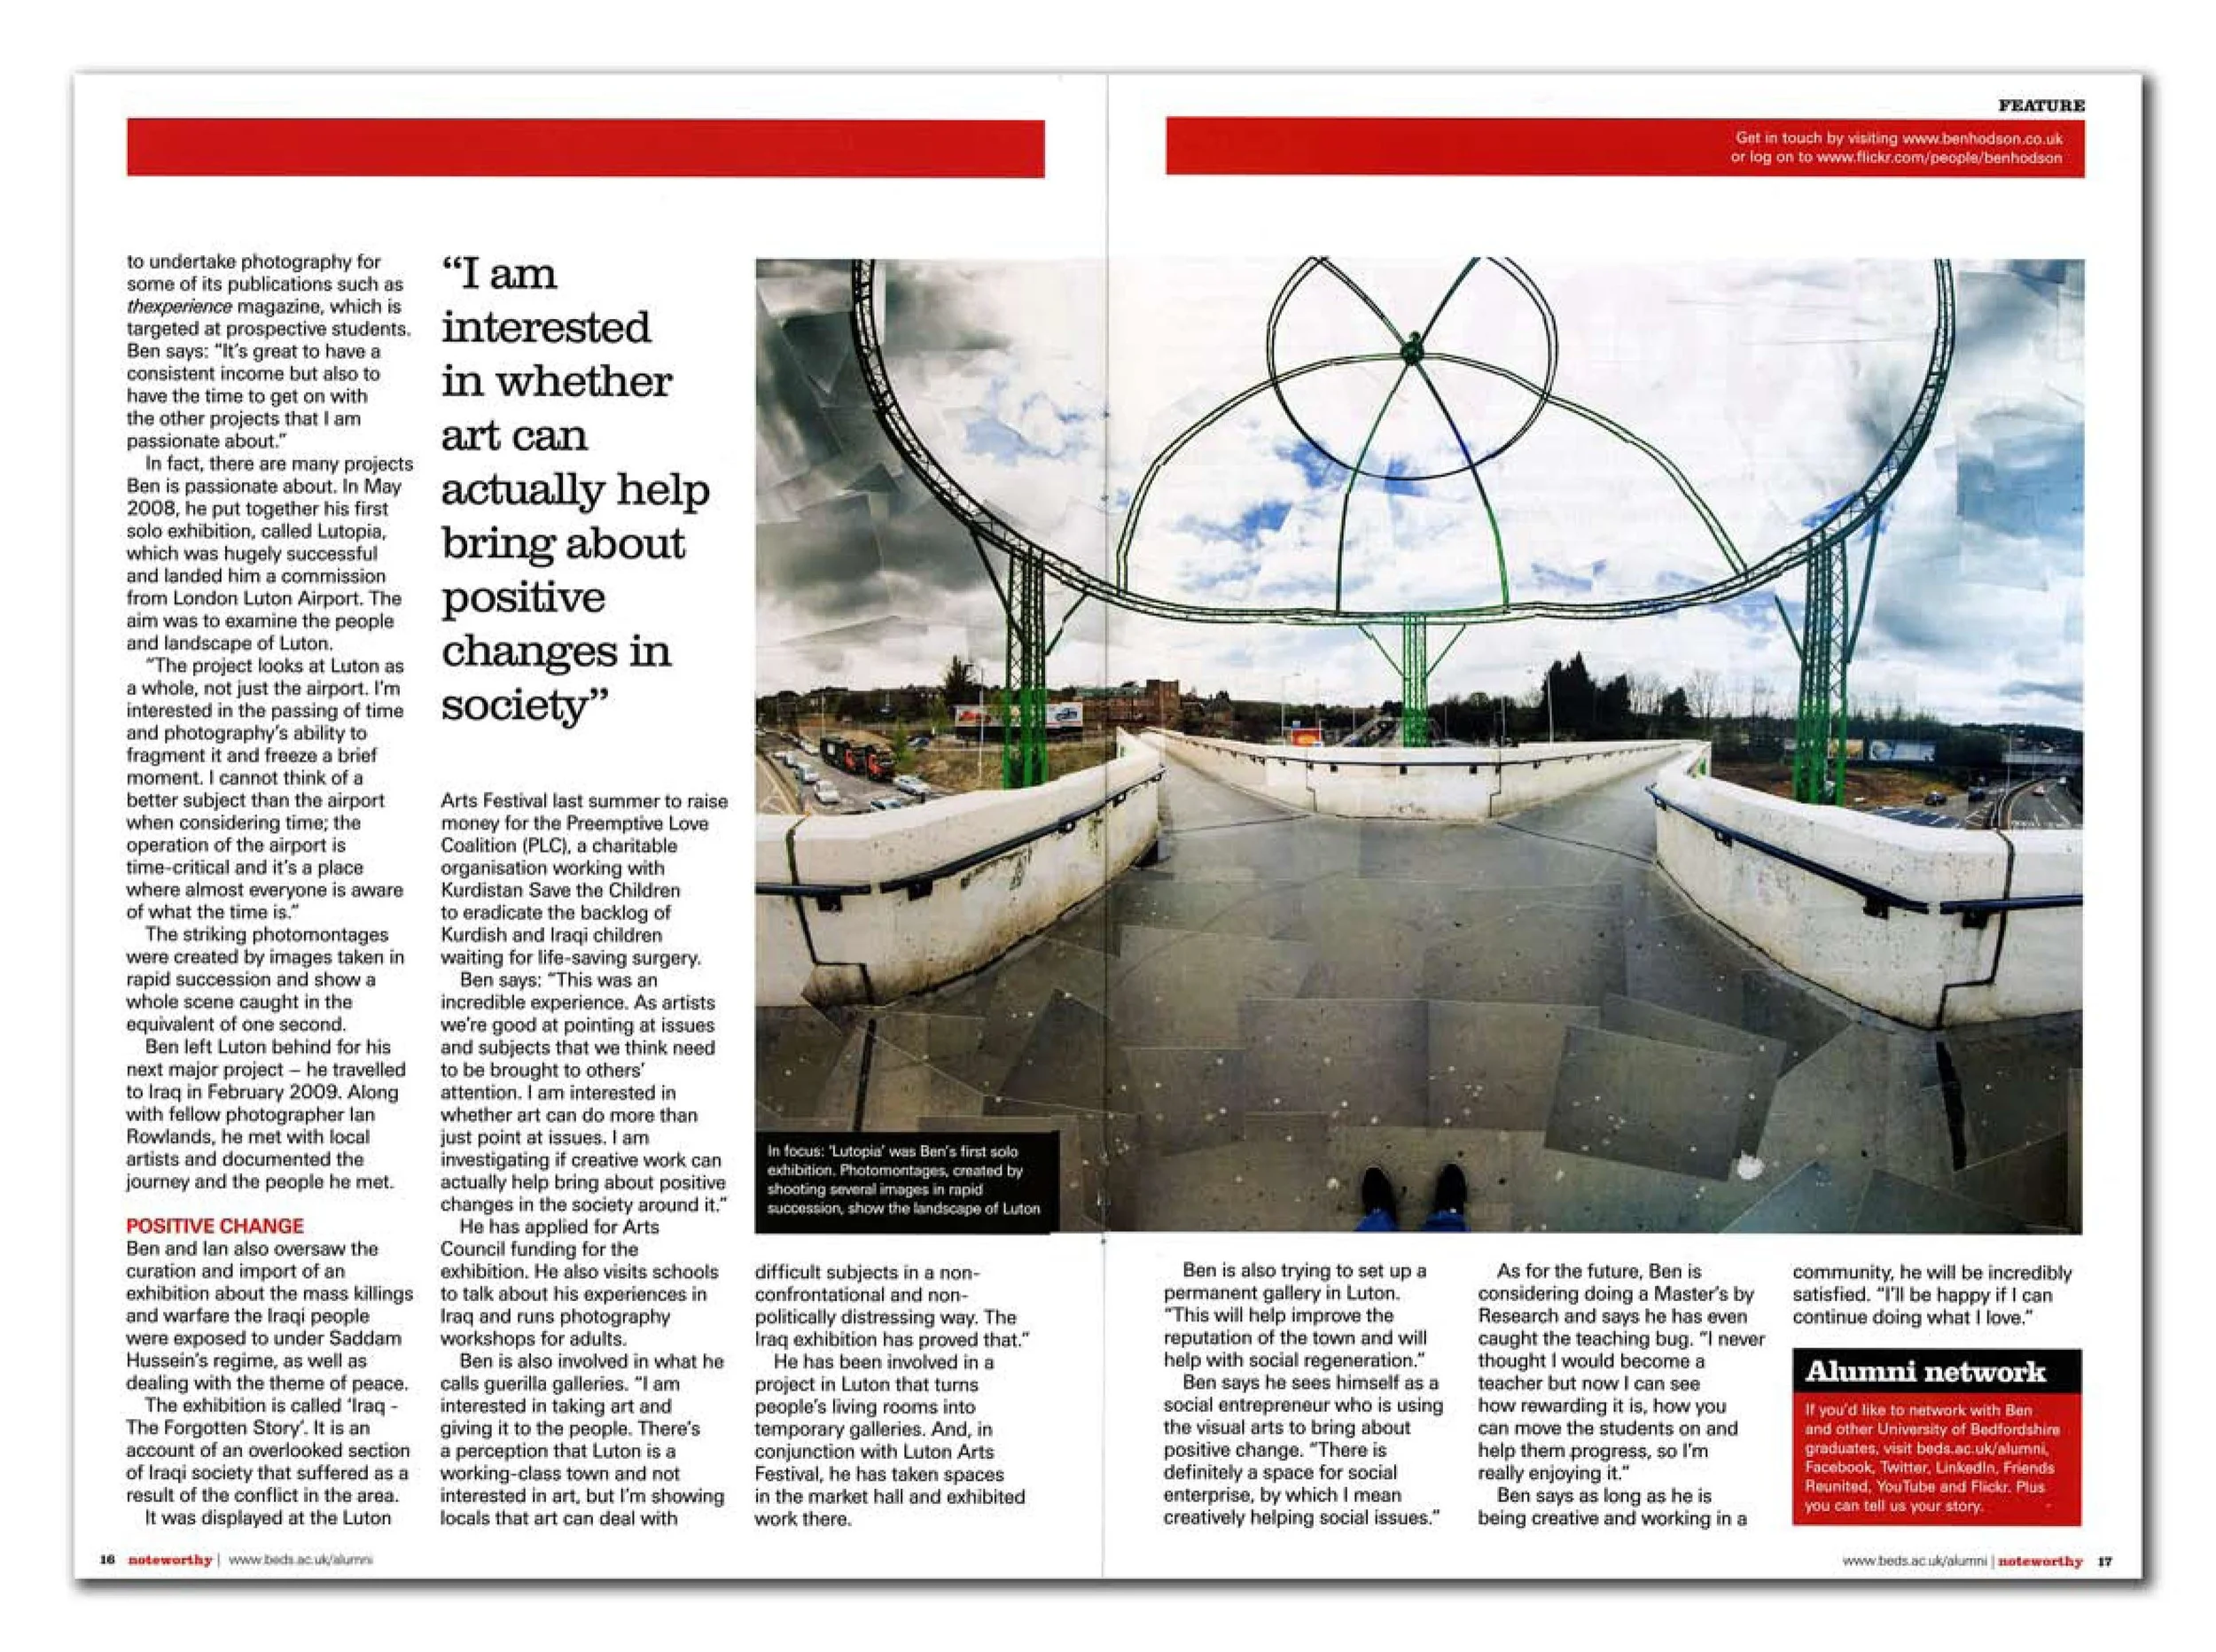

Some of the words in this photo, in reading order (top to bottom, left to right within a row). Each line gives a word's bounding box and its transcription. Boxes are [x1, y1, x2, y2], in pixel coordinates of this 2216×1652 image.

[1998, 98, 2086, 113] FEATURE
[1735, 130, 1761, 144] Get
[1765, 129, 1778, 144] in
[1782, 130, 1822, 145] touch
[1827, 130, 1845, 147] by
[1847, 129, 1899, 147] visiting
[1731, 152, 1746, 163] or
[1750, 150, 1772, 166] log
[1775, 152, 1795, 164] on
[1799, 151, 1814, 164] to
[127, 254, 145, 269] to
[149, 253, 238, 269] undertake
[241, 253, 352, 274] photography
[357, 253, 382, 269] for
[490, 264, 558, 290] am
[127, 297, 234, 318] thexperience
[238, 298, 325, 318] magazine,
[329, 298, 382, 315] which
[387, 298, 402, 315] is
[441, 308, 654, 345] interested
[441, 362, 486, 397] in
[495, 363, 675, 399] whether
[441, 419, 502, 452] art
[511, 425, 590, 452] can
[441, 471, 607, 515] actually
[616, 471, 711, 516] help
[127, 522, 164, 540] solo
[167, 522, 256, 541] exhibition,
[260, 522, 313, 540] called
[317, 522, 387, 543] Lutopia,
[440, 525, 558, 569] bring
[566, 525, 688, 560] about
[441, 579, 605, 623] positive
[441, 632, 619, 677] changes
[629, 633, 673, 667] in
[440, 836, 517, 853] Coalition
[522, 836, 572, 856] (PLC),
[577, 840, 588, 853] a
[592, 837, 678, 854] charitable
[441, 881, 524, 899] Kurdistan
[528, 881, 572, 899] Save
[575, 881, 604, 899] the
[609, 881, 681, 899] Children
[126, 1084, 144, 1100] to
[149, 1082, 182, 1103] Iraq
[187, 1083, 202, 1100] in
[207, 1082, 285, 1103] February
[288, 1082, 342, 1101] 2009.
[347, 1083, 399, 1105] Along
[767, 1144, 781, 1157] In
[784, 1142, 825, 1157] focus:
[888, 1147, 917, 1158] was
[960, 1144, 987, 1157] first
[990, 1144, 1019, 1159] solo
[767, 1163, 836, 1177] exhibition.
[839, 1163, 950, 1180] Photomontages,
[952, 1163, 1003, 1178] created
[1007, 1163, 1024, 1181] by
[767, 1182, 827, 1199] shooting
[829, 1182, 878, 1196] several
[879, 1182, 930, 1199] images
[932, 1185, 945, 1196] in
[948, 1181, 984, 1199] rapid
[767, 1201, 845, 1216] succession,
[847, 1201, 885, 1215] show
[888, 1201, 911, 1215] the
[913, 1201, 982, 1218] landscape
[984, 1201, 999, 1216] of
[1003, 1201, 1041, 1216] Luton
[126, 1217, 215, 1235] POSITIVE
[219, 1217, 305, 1235] CHANGE
[1792, 1264, 1894, 1284] community,
[1900, 1263, 1923, 1281] he
[1926, 1264, 1956, 1281] will
[1962, 1263, 1984, 1282] be
[1988, 1264, 2072, 1285] incredibly
[125, 1284, 209, 1302] exhibition
[215, 1284, 265, 1302] about
[269, 1284, 298, 1302] the
[303, 1289, 350, 1302] mass
[354, 1285, 414, 1305] killings
[753, 1285, 885, 1304] confrontational
[890, 1286, 923, 1304] and
[928, 1290, 969, 1304] non-
[1164, 1285, 1259, 1305] permanent
[1262, 1283, 1322, 1305] gallery
[1325, 1283, 1341, 1301] in
[1346, 1283, 1401, 1302] Luton.
[1478, 1284, 1580, 1305] considering
[1583, 1284, 1634, 1305] doing
[1637, 1289, 1649, 1302] a
[1733, 1285, 1755, 1305] by
[440, 1307, 474, 1329] Iraq
[479, 1307, 511, 1324] and
[517, 1311, 555, 1325] runs
[560, 1307, 671, 1329] photography
[1804, 1359, 1919, 1383] Alumni
[1923, 1360, 2048, 1383] network
[832, 1398, 878, 1418] living
[883, 1401, 939, 1414] rooms
[943, 1398, 977, 1414] into
[1163, 1396, 1213, 1413] social
[1218, 1398, 1331, 1416] entrepreneur
[1333, 1396, 1373, 1413] who
[1377, 1396, 1392, 1413] is
[1397, 1396, 1444, 1417] using
[1806, 1402, 1815, 1416] If
[1861, 1403, 1886, 1416] like
[1890, 1404, 1906, 1416] to
[1909, 1403, 1967, 1416] network
[1970, 1403, 2001, 1416] with
[2005, 1403, 2033, 1416] Ben
[1805, 1422, 1832, 1436] and
[1835, 1422, 1874, 1436] other
[1877, 1422, 1948, 1438] University
[1951, 1422, 1967, 1436] of
[1970, 1422, 2061, 1437] Bedfordshire
[1804, 1441, 1879, 1458] graduates,
[1883, 1441, 1913, 1454] visit
[1916, 1441, 2049, 1456] beds.ac.uk/alumni,
[1806, 1460, 1876, 1475] Facebook,
[1879, 1460, 1931, 1475] Twitter,
[1936, 1460, 1999, 1475] LinkedIn,
[2003, 1460, 2056, 1475] Friends
[1805, 1478, 1872, 1494] Reunited,
[1876, 1478, 1936, 1493] YouTube
[1939, 1480, 1967, 1493] and
[1970, 1478, 2012, 1493] Flickr.
[2016, 1479, 2046, 1493] Plus
[1804, 1501, 1830, 1515] you
[1834, 1501, 1861, 1512] can
[1864, 1499, 1885, 1512] tell
[1889, 1501, 1908, 1512] us
[1909, 1501, 1941, 1516] your
[1945, 1500, 1982, 1516] story.
[100, 1554, 116, 1565] 16
[127, 1554, 214, 1569] noteworthy
[1997, 1555, 2084, 1570] noteworthy
[2097, 1555, 2114, 1568] 17
